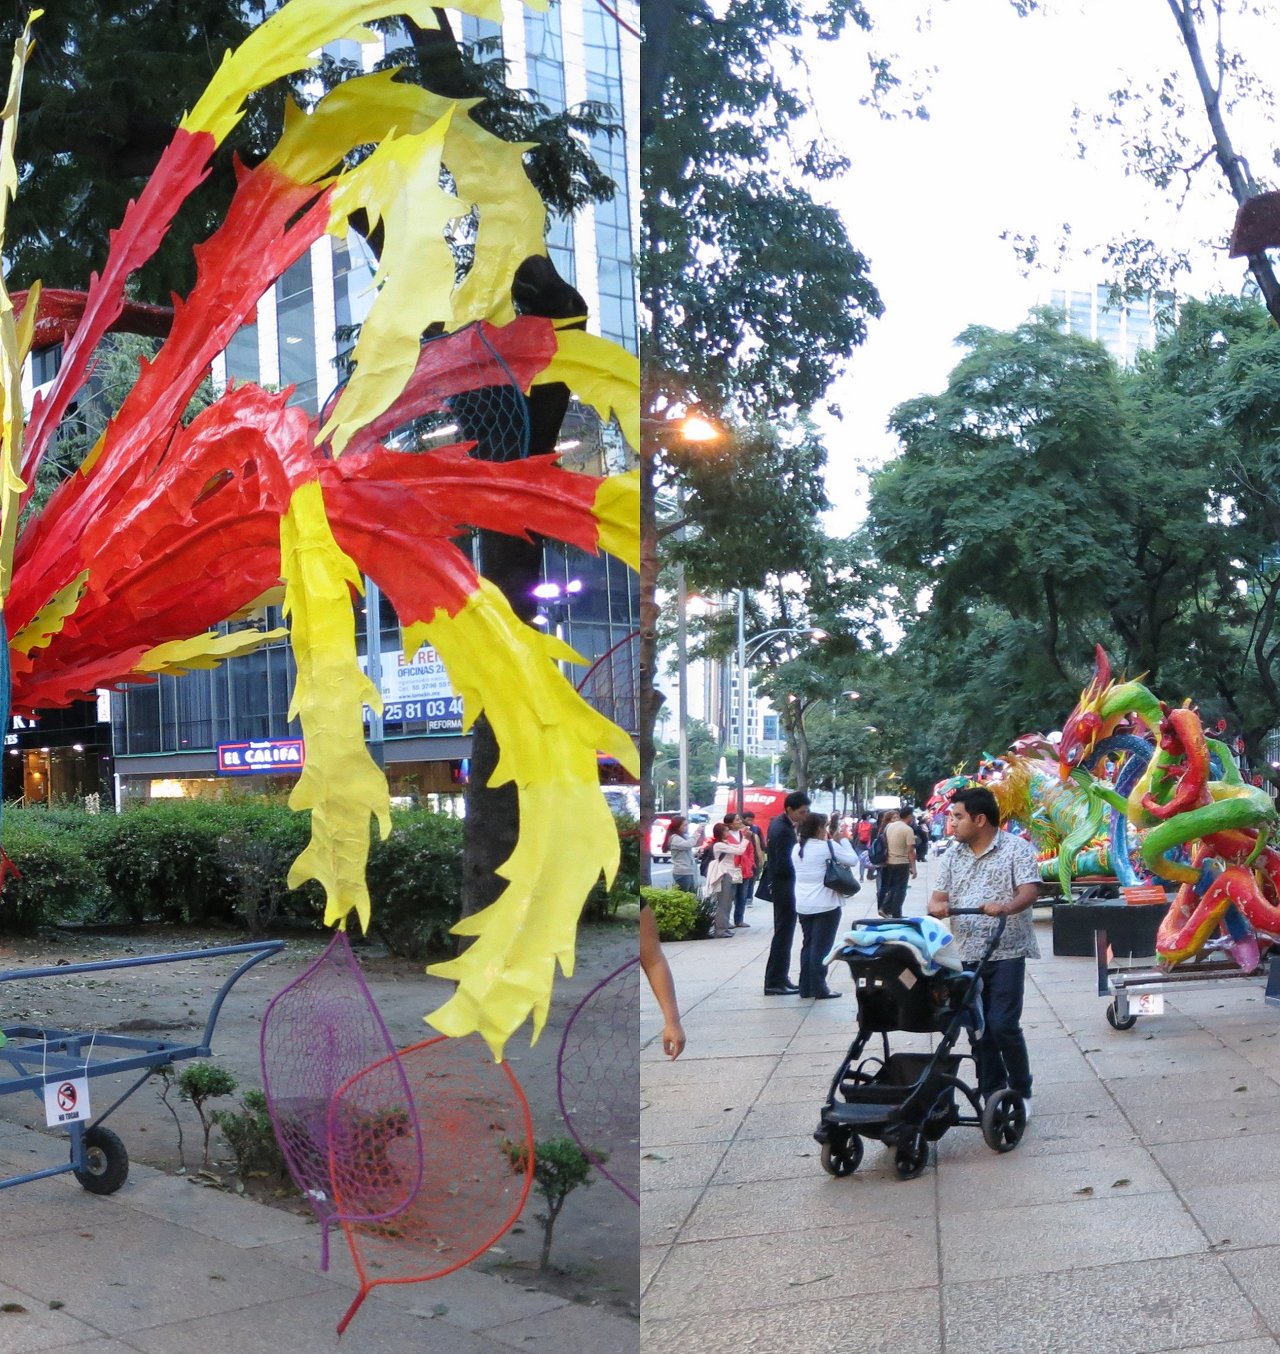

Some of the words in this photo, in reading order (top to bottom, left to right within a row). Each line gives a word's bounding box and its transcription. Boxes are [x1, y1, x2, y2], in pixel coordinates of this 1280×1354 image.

[398, 665, 434, 678] OFICINAS
[385, 704, 402, 721] 25
[405, 702, 422, 719] 81
[426, 701, 445, 717] 03
[428, 720, 463, 730] REFORMA
[224, 751, 240, 765] EL
[244, 747, 299, 763] CALIFA
